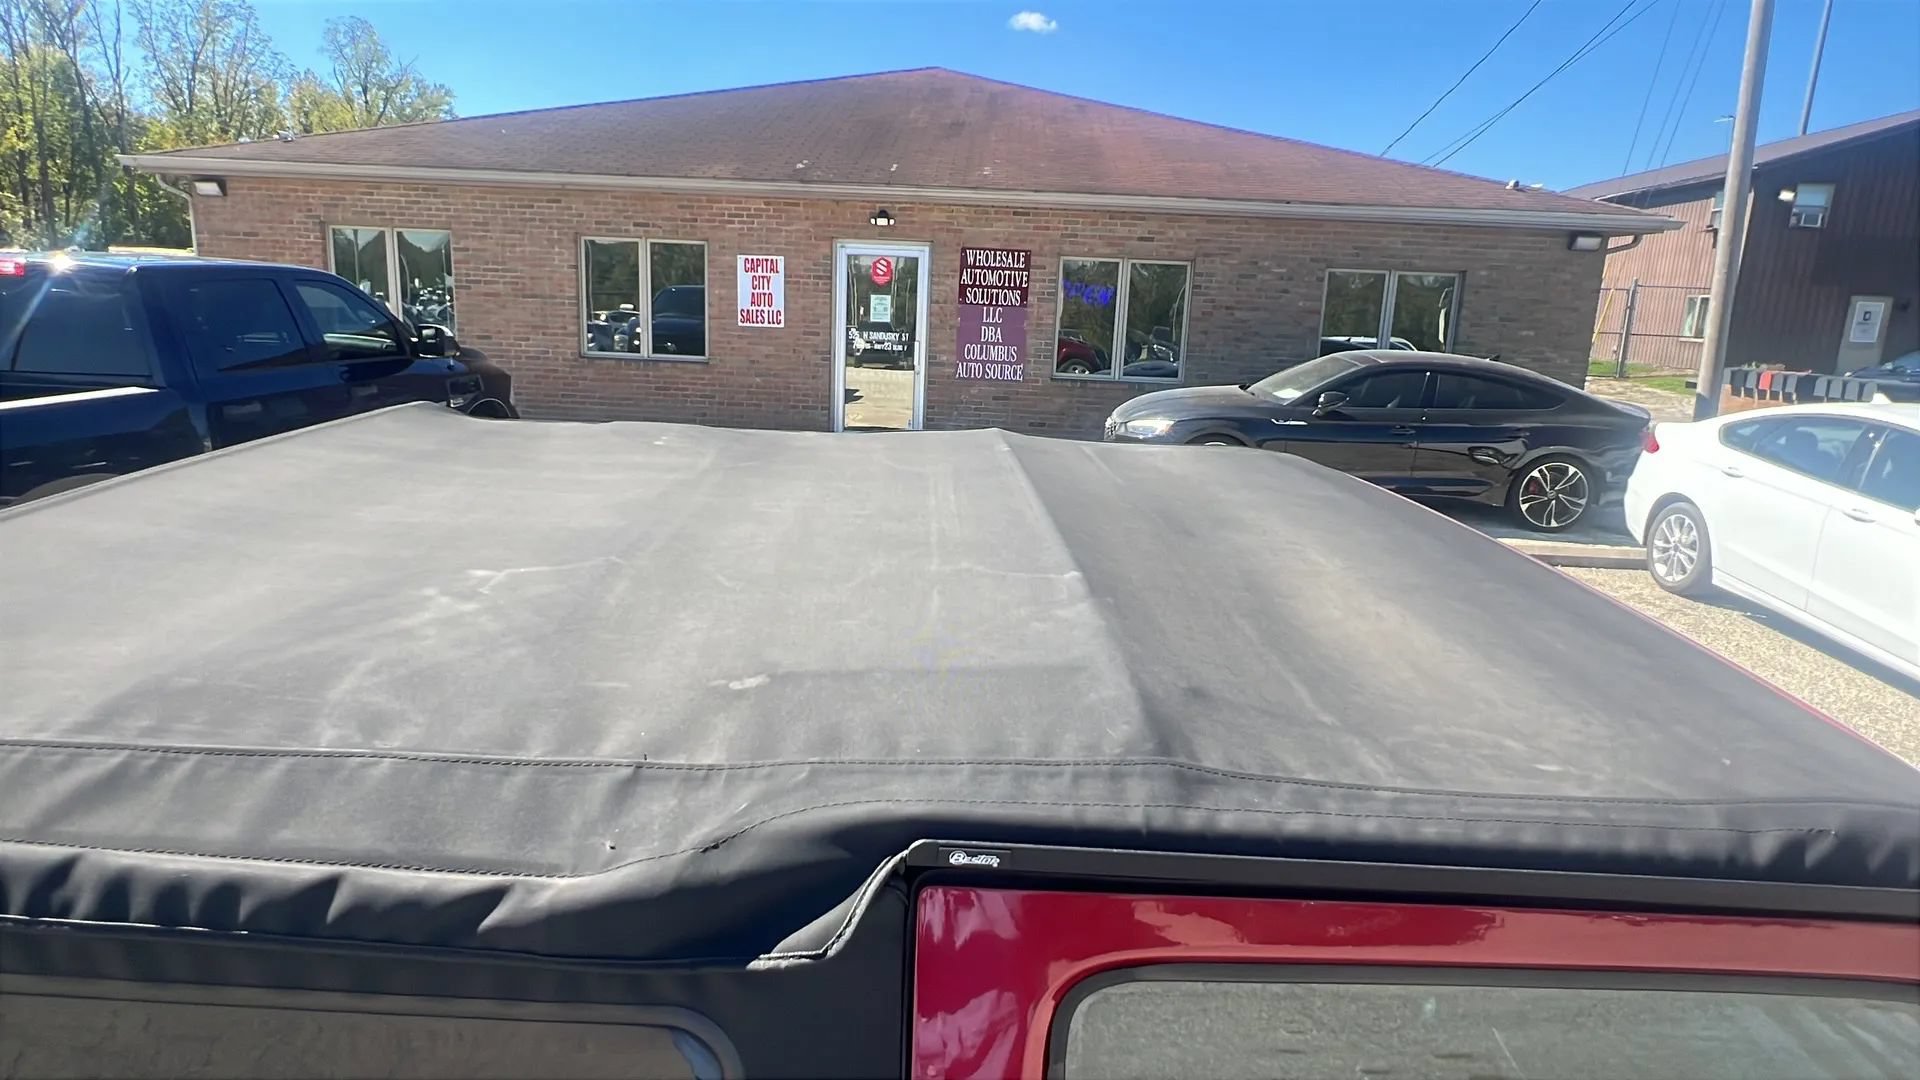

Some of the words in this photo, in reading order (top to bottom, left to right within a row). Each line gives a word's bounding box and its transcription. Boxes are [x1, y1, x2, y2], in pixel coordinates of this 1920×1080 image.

[744, 257, 780, 274] CAPITAL
[966, 249, 1026, 268] WHOLESALE
[751, 275, 772, 291] CITY
[960, 268, 1029, 288] AUTOMOTIVE
[750, 292, 773, 308] AUTO
[965, 287, 1021, 306] SOLUTIONS
[739, 309, 765, 324] SALES
[767, 309, 782, 326] LLC
[982, 306, 1003, 323] LLC
[869, 331, 900, 341] SANDUSKY
[980, 325, 1003, 343] DBA
[964, 343, 1018, 362] COLUMBUS
[955, 361, 983, 379] AUTO
[984, 363, 1024, 382] SOURCE
